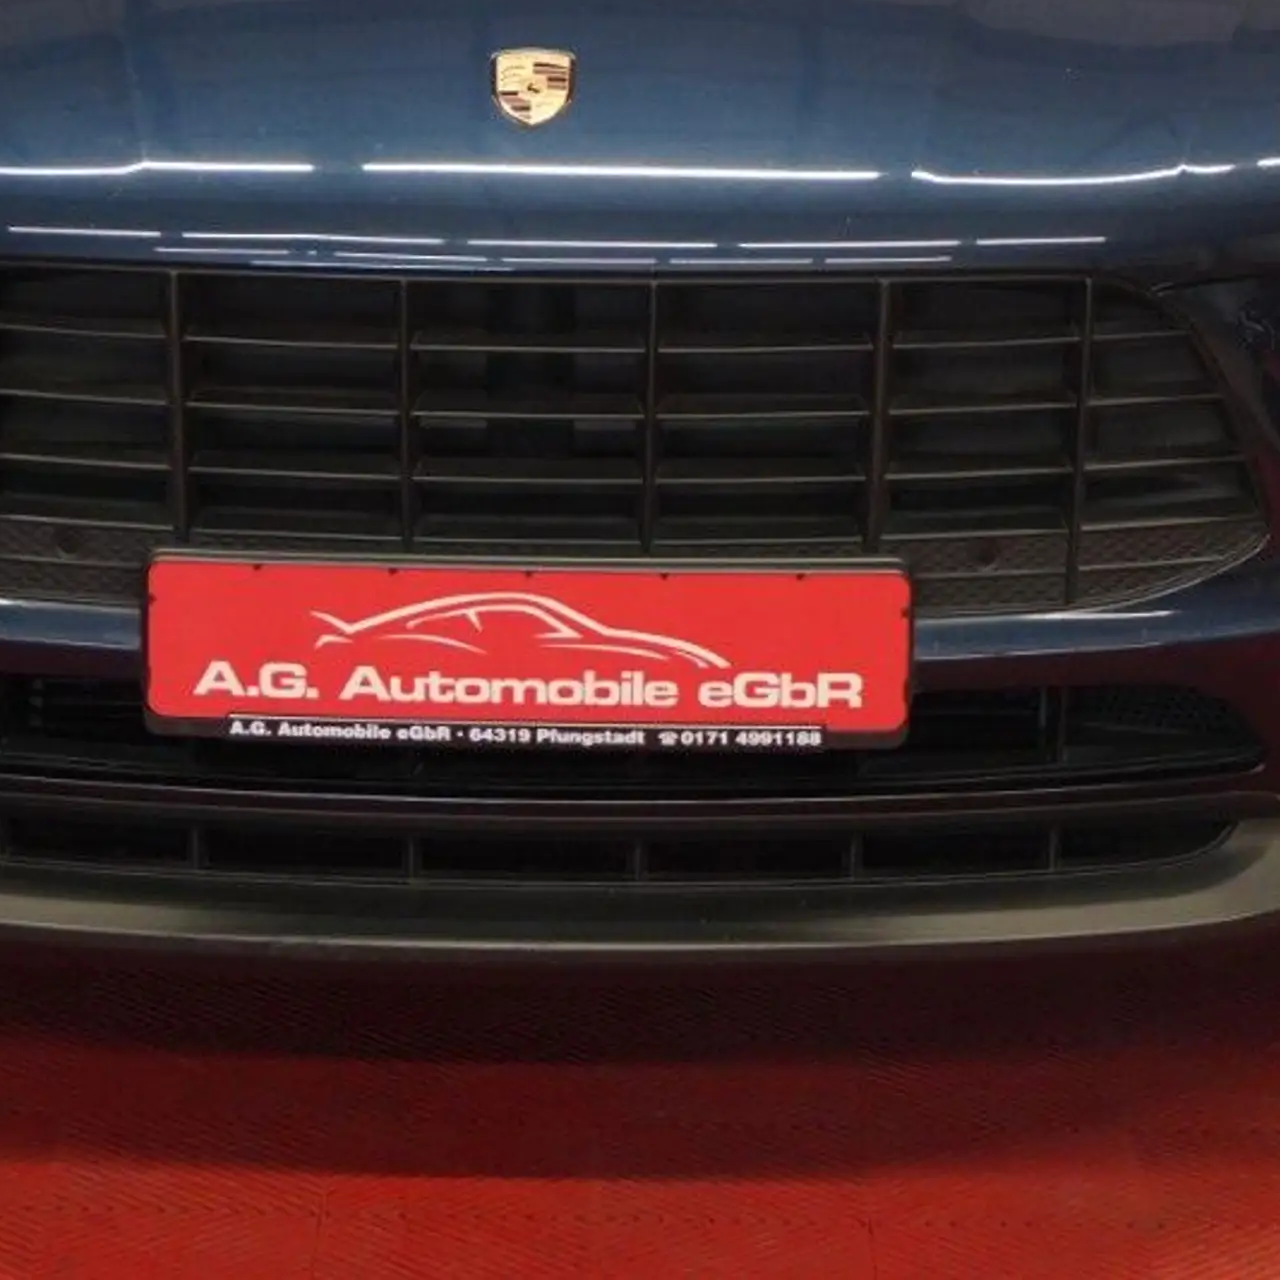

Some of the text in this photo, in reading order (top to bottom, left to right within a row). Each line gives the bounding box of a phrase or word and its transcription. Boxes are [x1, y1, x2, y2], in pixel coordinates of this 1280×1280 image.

[193, 660, 863, 709] A.G. Automobile eGbR
[229, 720, 271, 736] A.G.
[278, 721, 391, 740] Automobile
[396, 725, 451, 741] eGbR
[469, 728, 531, 743] 64319
[536, 728, 646, 747] Pfungstadt
[680, 730, 728, 746] 0171
